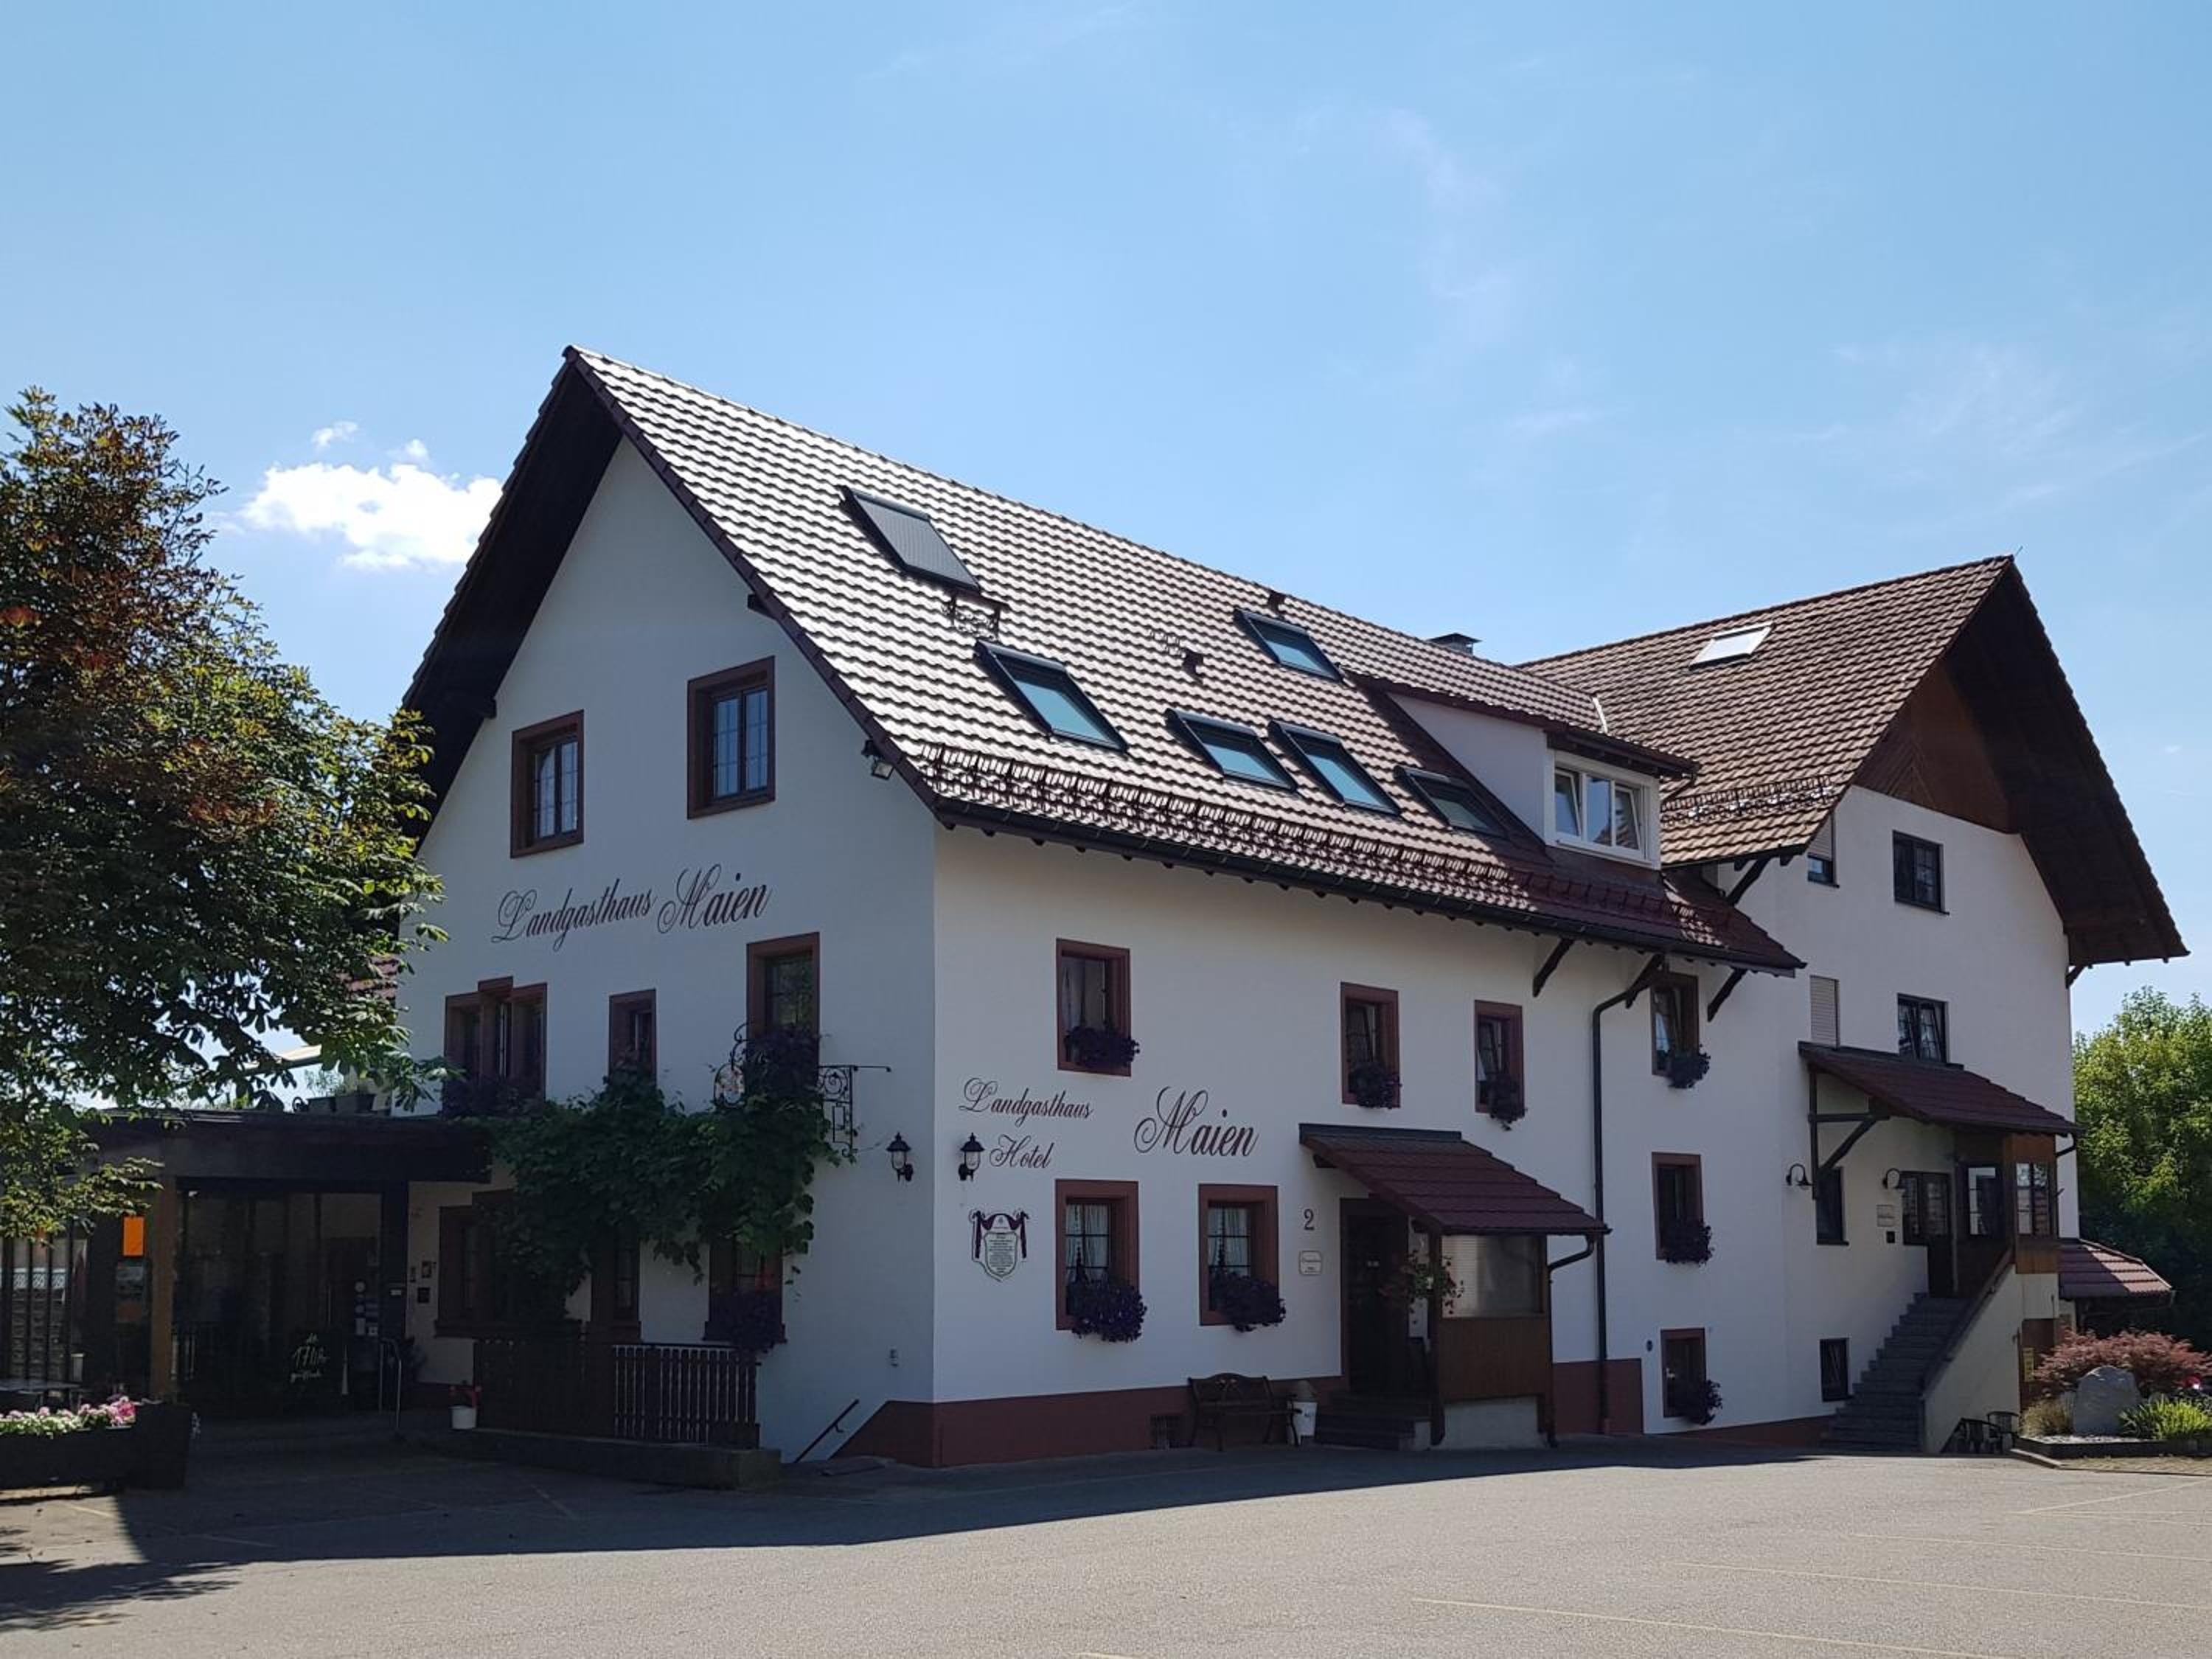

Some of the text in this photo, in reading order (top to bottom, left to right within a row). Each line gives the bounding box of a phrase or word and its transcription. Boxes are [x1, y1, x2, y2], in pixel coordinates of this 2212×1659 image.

[491, 863, 772, 951] Landgasthaus Maien
[959, 1077, 1093, 1127] Landgasthaus
[1133, 1086, 1258, 1157] Maien
[989, 1134, 1054, 1169] Hotel
[1303, 1208, 1315, 1231] 2
